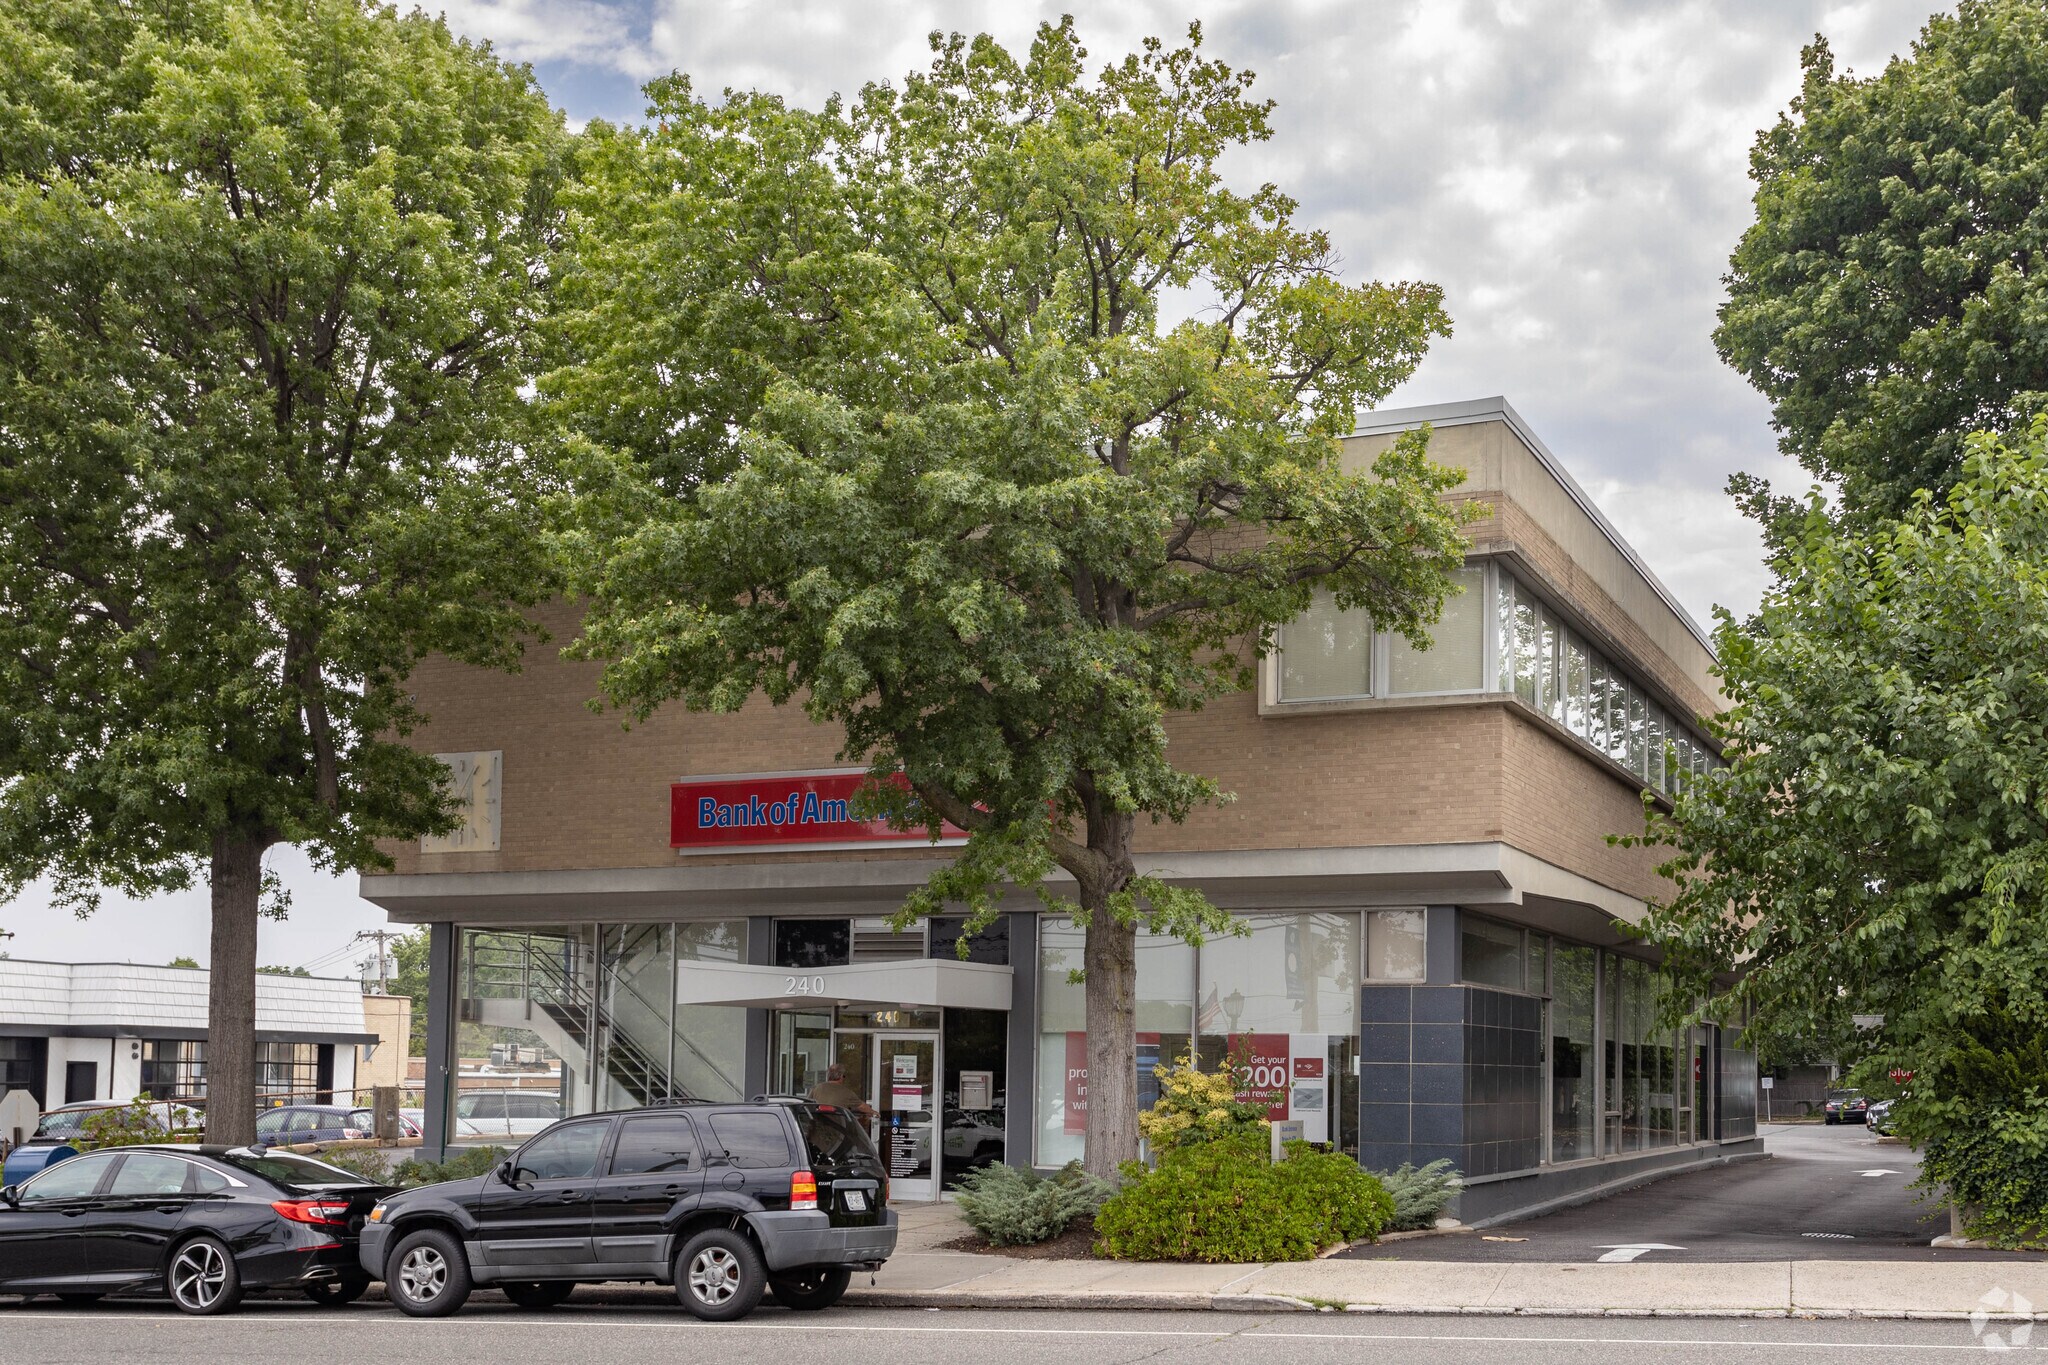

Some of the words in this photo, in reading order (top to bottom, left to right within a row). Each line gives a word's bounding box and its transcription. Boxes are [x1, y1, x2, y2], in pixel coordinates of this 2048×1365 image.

[698, 795, 768, 828] Bank
[769, 792, 799, 825] of
[785, 976, 825, 995] 240
[876, 1011, 900, 1023] 240
[1250, 1055, 1266, 1064] Get
[1267, 1056, 1286, 1066] your
[1232, 1066, 1286, 1088] 200
[1235, 1089, 1250, 1098] ash
[1252, 1089, 1285, 1098] rewa
